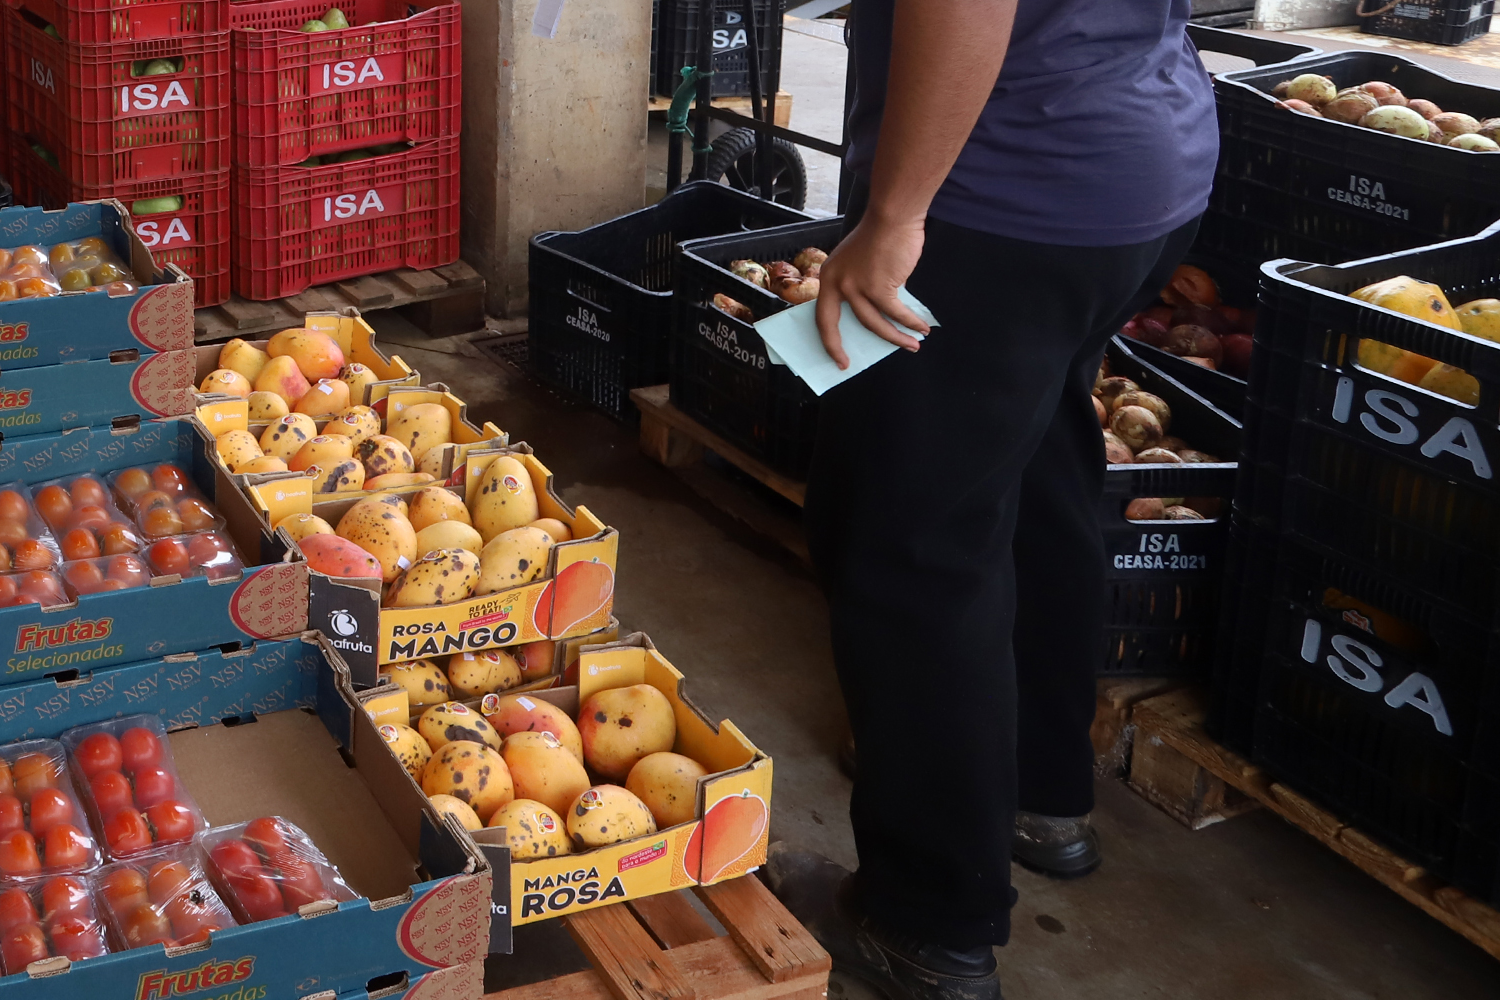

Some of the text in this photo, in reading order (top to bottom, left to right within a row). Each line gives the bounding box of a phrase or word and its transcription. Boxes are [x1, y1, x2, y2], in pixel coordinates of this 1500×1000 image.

[712, 29, 748, 48] SA
[31, 58, 54, 94] ISA
[323, 58, 384, 90] ISA
[121, 80, 190, 113] ISA
[1350, 175, 1386, 200] ISA
[323, 190, 385, 222] ISA
[1328, 187, 1409, 220] CEASA-2021
[3, 217, 29, 237] NSV
[34, 218, 61, 237] NSV
[66, 212, 92, 230] NSV
[137, 218, 190, 246] SA
[578, 306, 598, 327] ISA
[566, 315, 610, 342] CEASA-2020
[716, 322, 738, 344] ISA
[699, 322, 765, 370] CEASA-2018
[1332, 376, 1494, 480] ISA
[60, 439, 91, 462] NSV
[97, 439, 126, 462] NSV
[132, 430, 162, 453] NSV
[23, 449, 53, 472] NSV
[1140, 532, 1181, 553] ISA
[278, 564, 296, 579] NSV
[1113, 553, 1207, 570] CEASA-2021
[260, 569, 274, 581] NSV
[278, 579, 296, 594] NSV
[278, 594, 296, 609] NSV
[469, 600, 498, 613] READY
[483, 605, 501, 615] EAT!
[278, 609, 295, 624] NSV
[14, 617, 114, 654] Frutas
[392, 620, 446, 637] ROSA
[388, 622, 518, 661] MANGO
[6, 643, 123, 674] Selecionadas
[252, 646, 286, 675] NSV
[599, 664, 621, 672] boafruta
[166, 662, 202, 690] NSV
[210, 660, 245, 688] NSV
[1300, 618, 1453, 737] ISA
[79, 676, 116, 706] NSV
[123, 674, 160, 703] NSV
[252, 686, 287, 714] NSV
[34, 690, 71, 720] NSV
[640, 852, 657, 862] mundo
[460, 878, 480, 895] NSV
[524, 866, 599, 892] MANGA
[437, 886, 454, 900] NSV
[458, 895, 479, 912] NSV
[521, 876, 626, 918] ROSA
[458, 912, 478, 930] NSV
[457, 930, 477, 947] NSV
[456, 947, 476, 964] NSV
[134, 954, 256, 1000] Frutas
[453, 960, 471, 978] NSV
[452, 979, 471, 994] NSV
